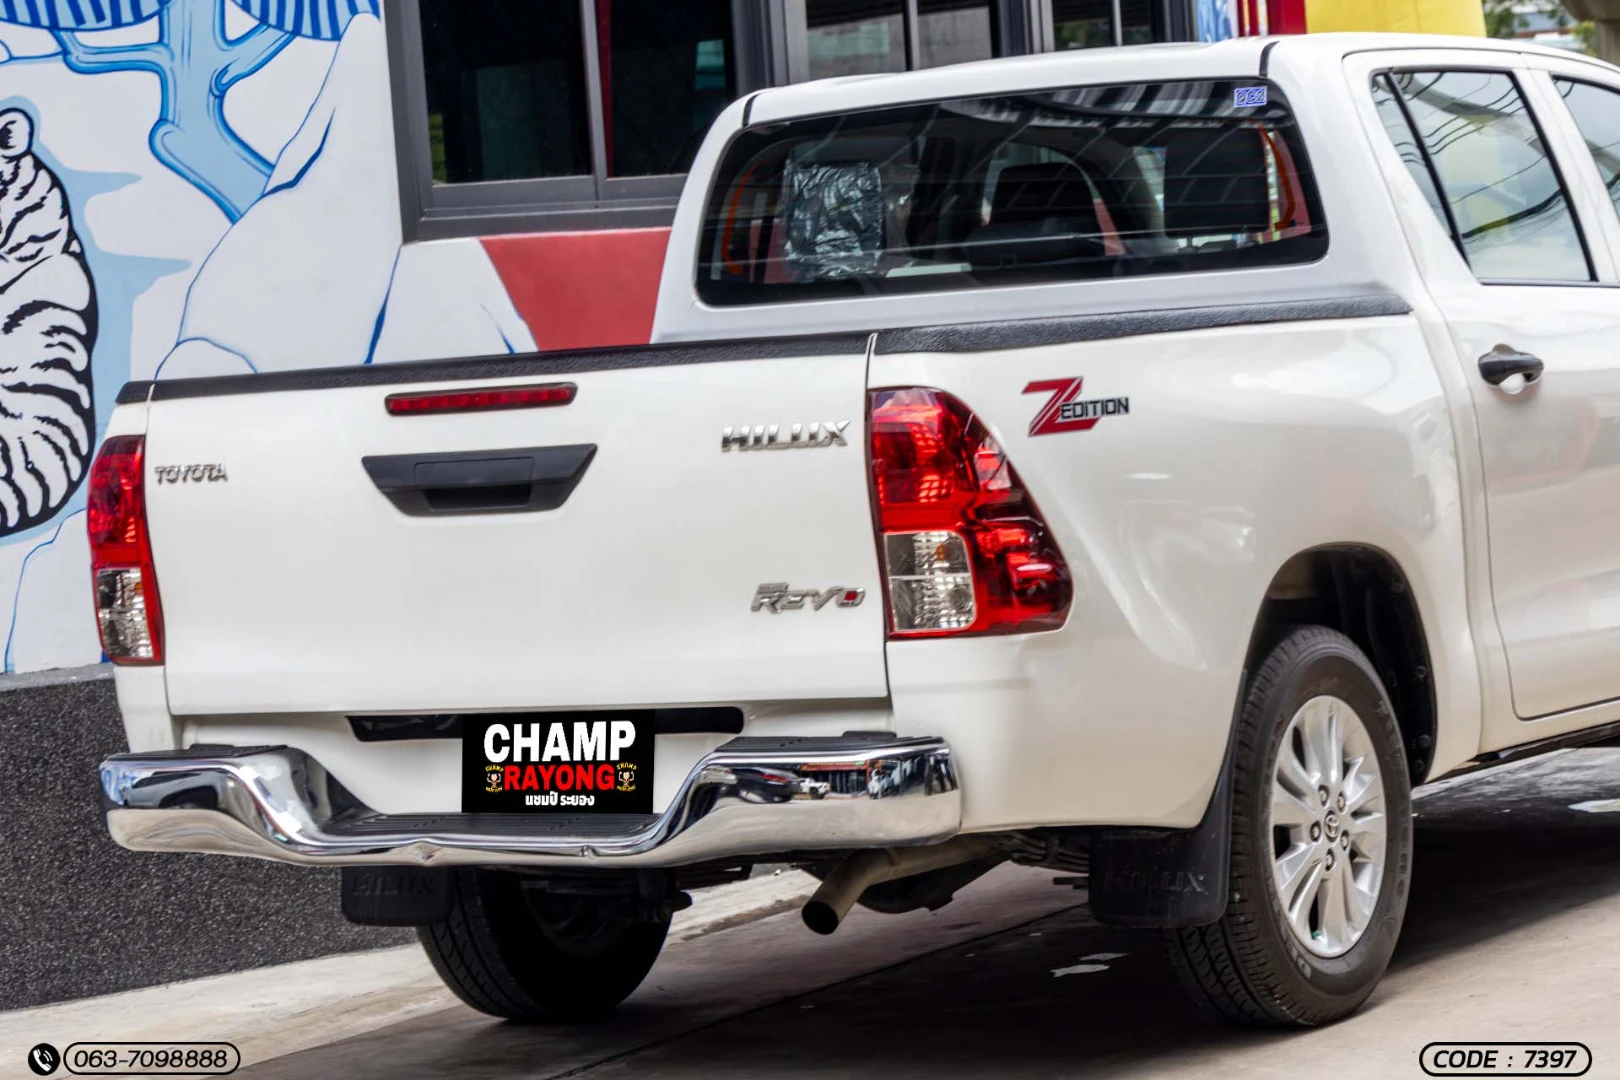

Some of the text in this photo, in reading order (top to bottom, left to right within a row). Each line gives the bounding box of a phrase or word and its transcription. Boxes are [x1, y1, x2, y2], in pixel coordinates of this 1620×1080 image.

[1020, 376, 1099, 437] Z
[1061, 398, 1130, 420] EDITION
[721, 419, 850, 452] HILUX
[155, 464, 228, 485] TOYOTA
